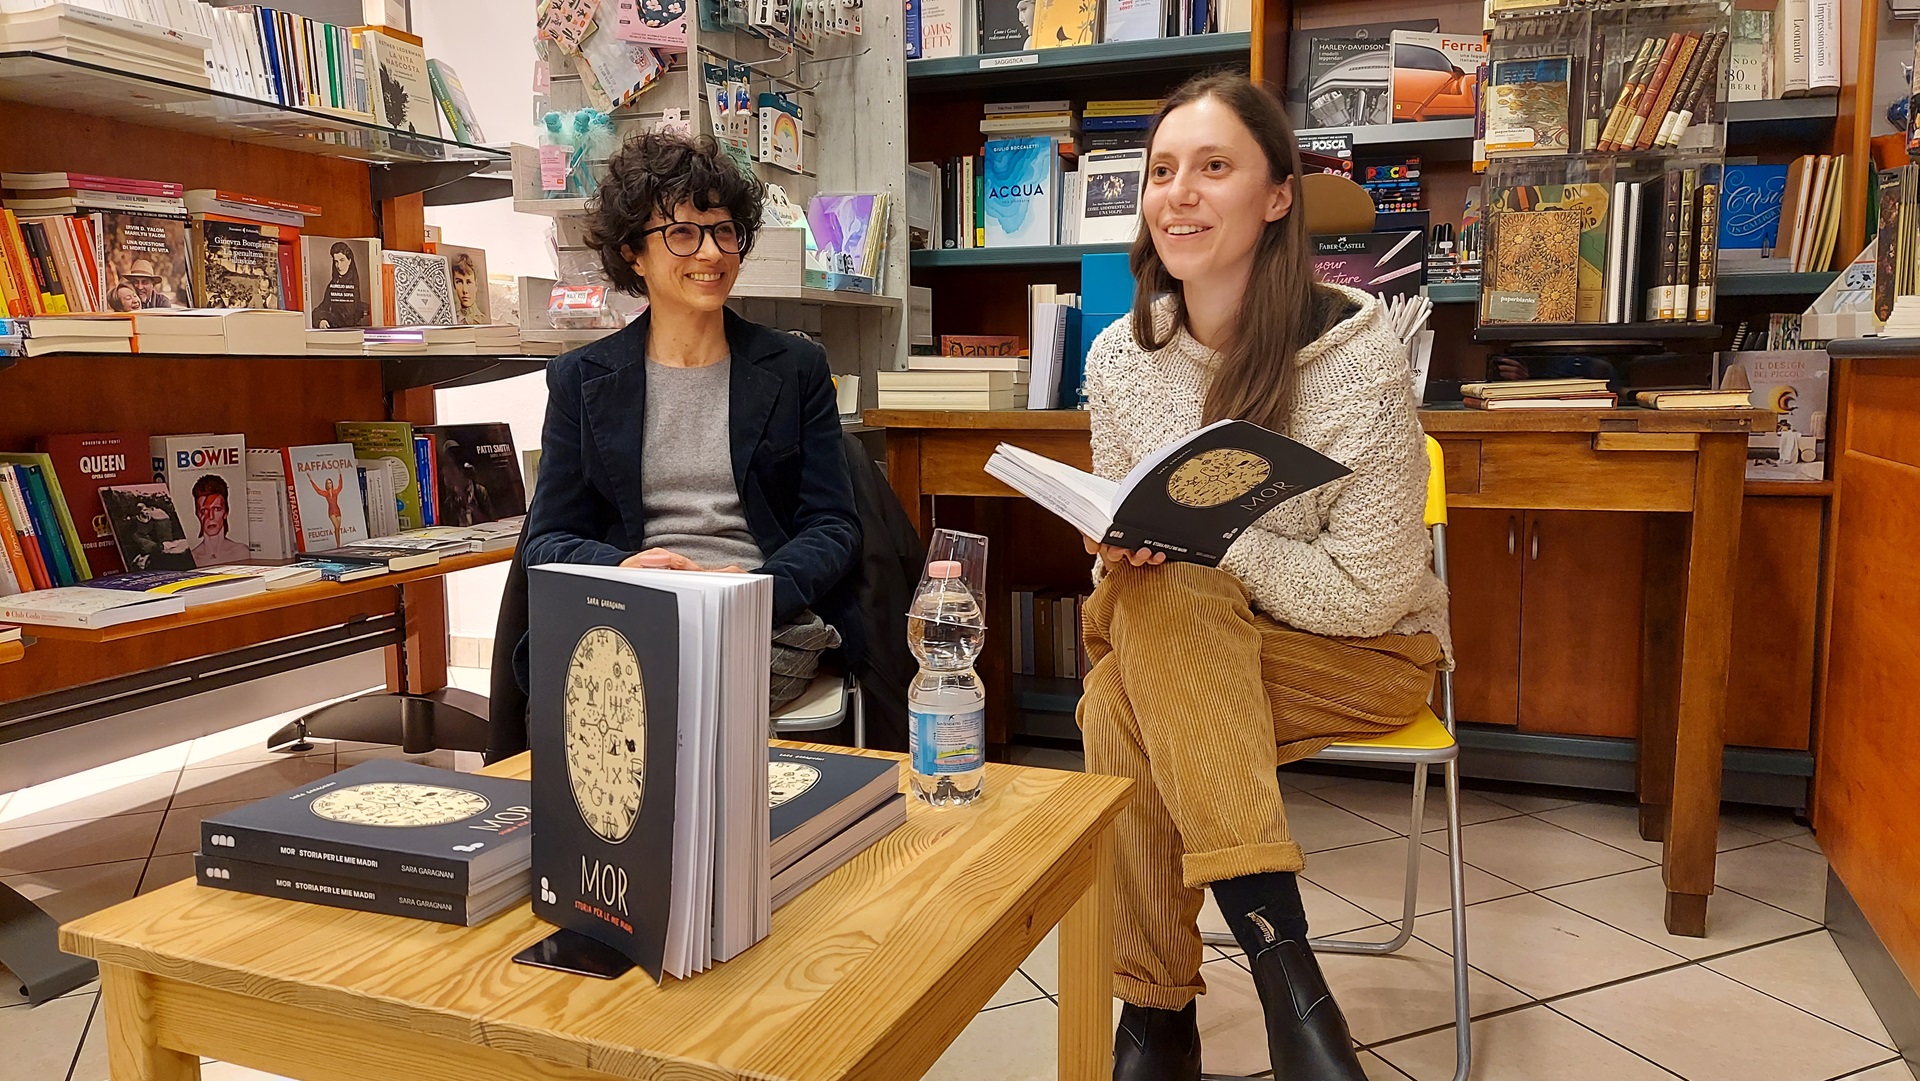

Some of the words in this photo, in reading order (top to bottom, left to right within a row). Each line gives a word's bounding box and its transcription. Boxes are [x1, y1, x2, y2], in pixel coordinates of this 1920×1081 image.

[923, 22, 952, 37] OMAS
[1815, 2, 1827, 67] Impressionismo
[922, 35, 953, 50] ETTY
[1442, 39, 1483, 52] Ferra
[1793, 19, 1805, 64] Leonardo
[388, 50, 398, 59] LA
[398, 54, 414, 64] VITA
[994, 58, 1024, 66] SAGGISTICA
[1721, 57, 1758, 66] ONDO
[385, 57, 421, 74] NASCOSTA
[1720, 83, 1757, 91] LBERI
[1312, 140, 1347, 151] POSCA
[1366, 166, 1409, 180] POSCA
[988, 183, 1045, 199] ACQUA
[1564, 184, 1582, 202] ON
[124, 230, 147, 238] MARILYN
[214, 236, 241, 246] Ginevra
[138, 240, 165, 248] QUESTIONE
[1500, 296, 1537, 305] paperblanks
[1754, 362, 1765, 370] IL
[1767, 361, 1805, 370] DESIGN
[176, 447, 240, 468] BOWIE
[476, 445, 493, 455] PATTI
[79, 454, 126, 474] QUEEN
[297, 459, 353, 473] RAFFASOFIA
[1240, 481, 1295, 511] MOR
[287, 485, 301, 533] RAFFASOFIA
[586, 596, 600, 607] SARA
[600, 599, 626, 611] GARAGNANI
[468, 805, 532, 832] MOR
[280, 846, 296, 856] MOR
[299, 848, 322, 860] STORIA
[323, 853, 336, 861] PER
[335, 854, 343, 862] LE
[343, 855, 356, 865] MIE
[356, 857, 378, 868] MADRI
[400, 864, 418, 873] SARA
[418, 867, 455, 880] GARAGNANI
[581, 854, 629, 917] MOR
[276, 879, 292, 888] MOR
[295, 881, 319, 892] STORIA
[319, 886, 332, 894] PER
[332, 887, 340, 895] LE
[340, 888, 353, 897] MIE
[353, 889, 376, 900] MADRI
[398, 897, 416, 906] SARA
[416, 899, 453, 912] GARAGNANI
[574, 900, 592, 914] STORIA
[593, 906, 603, 919] PER
[603, 912, 610, 922] LE
[610, 915, 620, 927] MIE
[620, 919, 634, 935] MADRI
